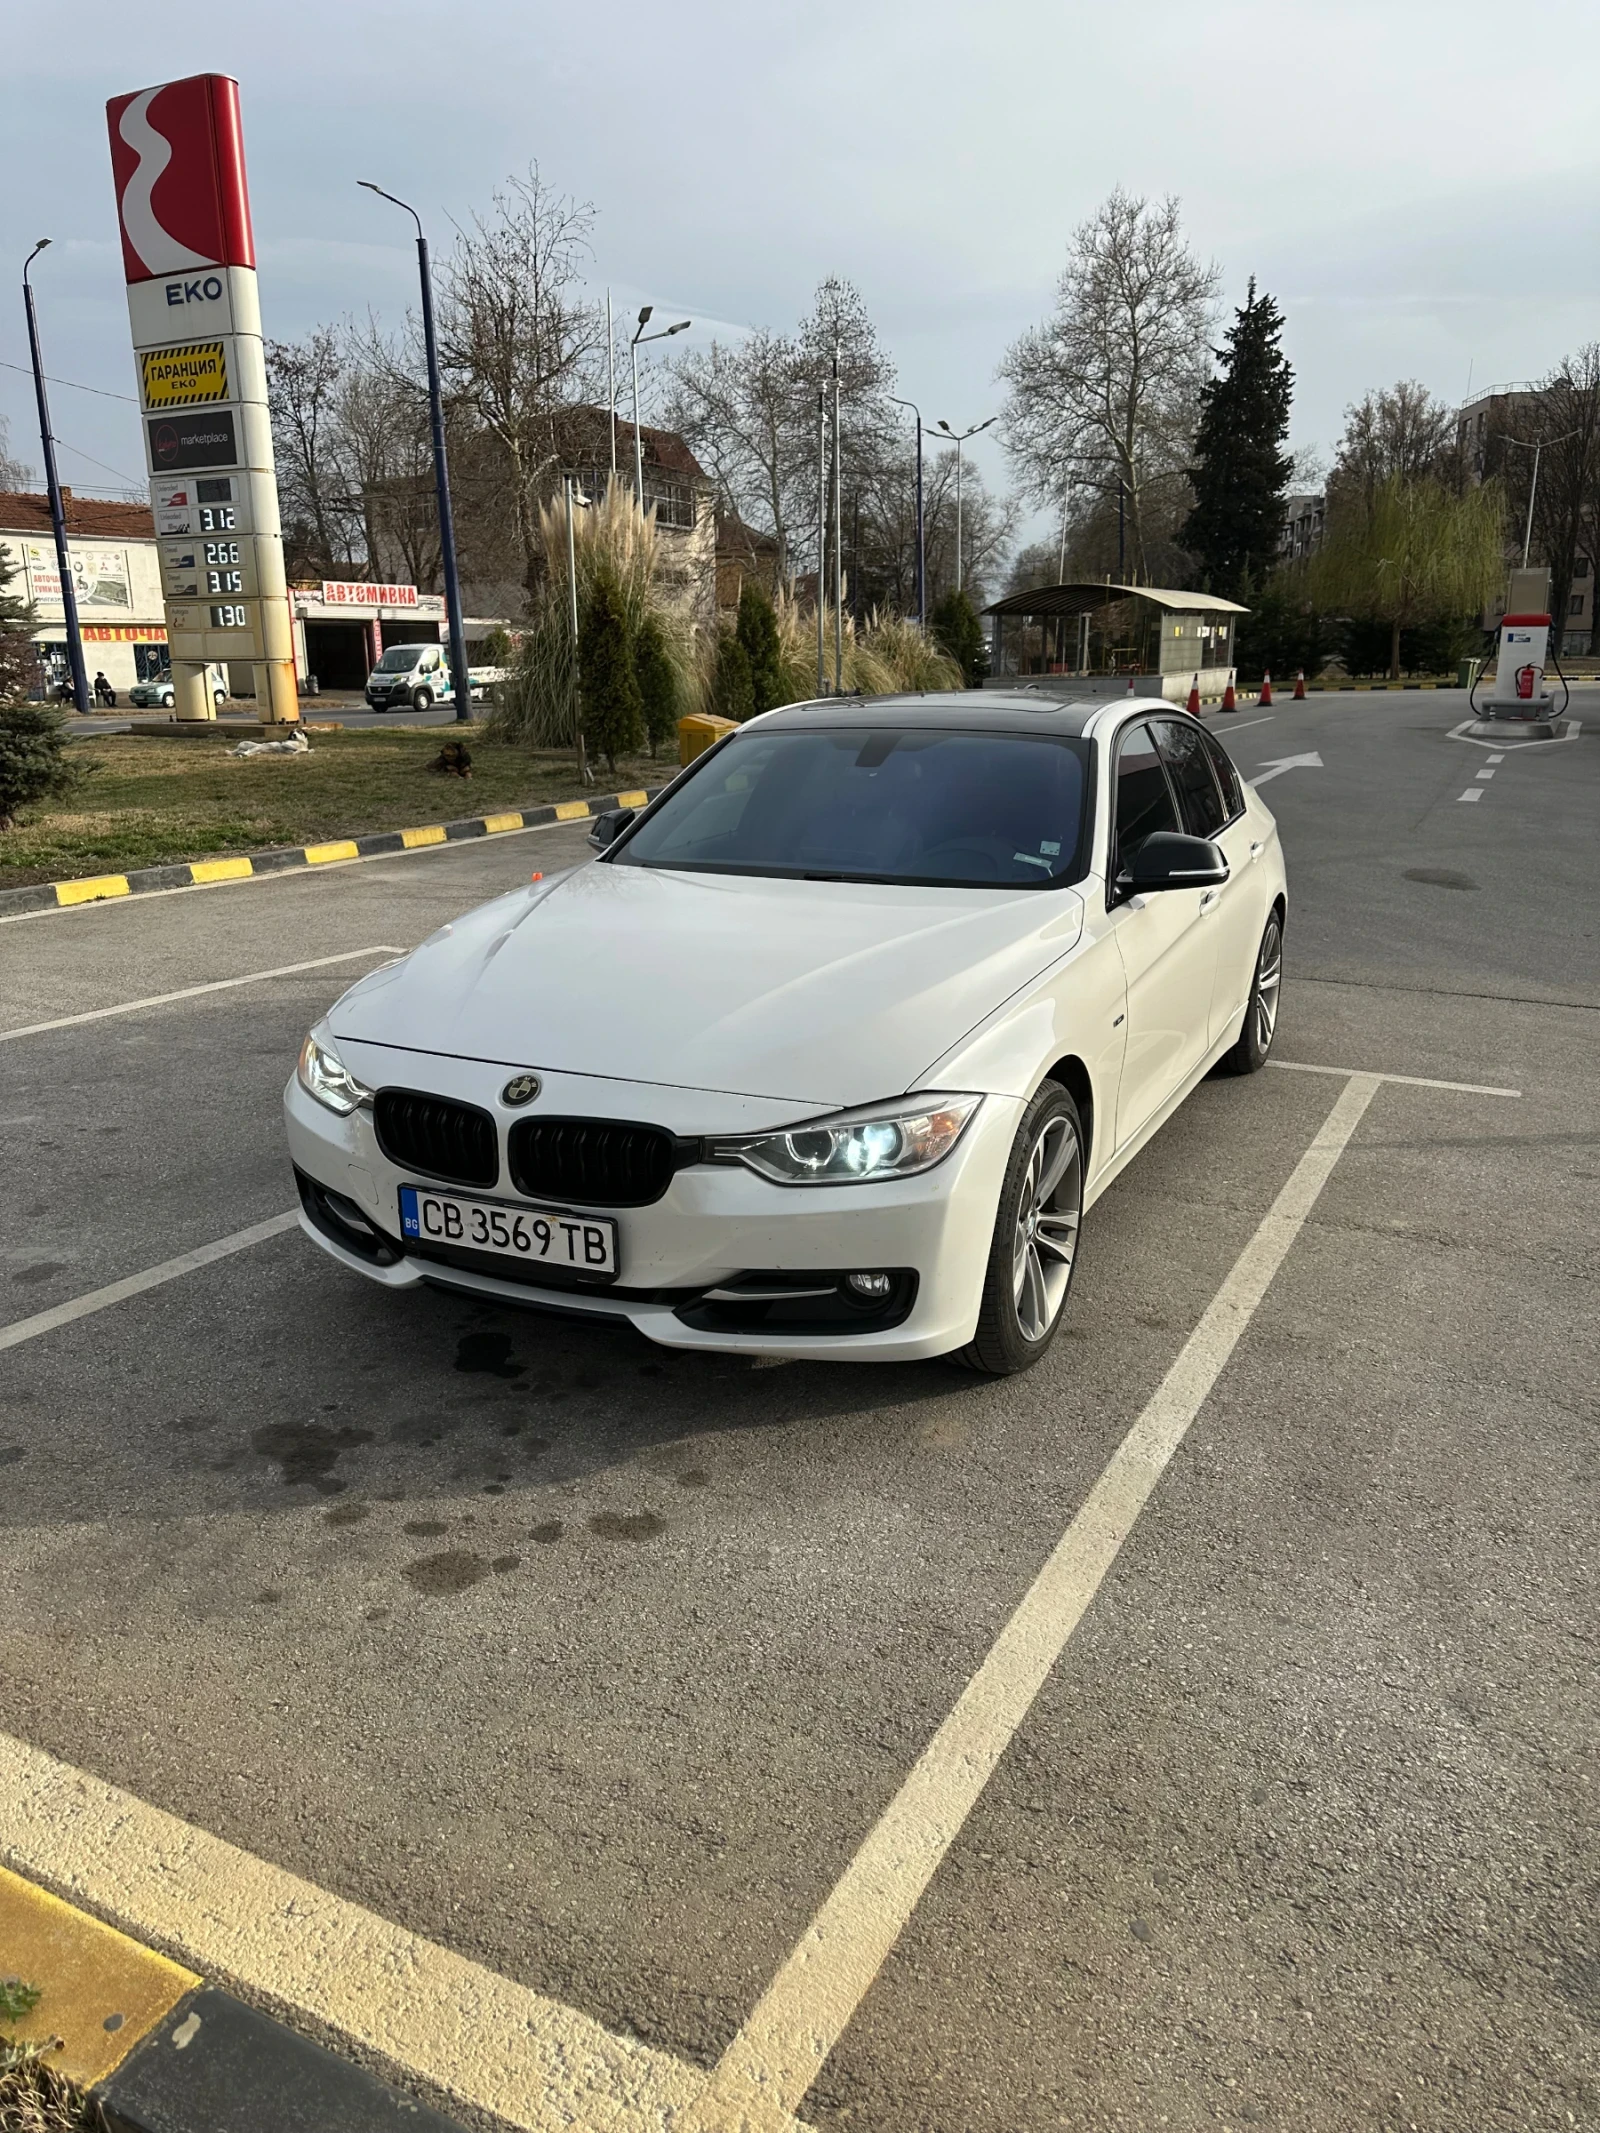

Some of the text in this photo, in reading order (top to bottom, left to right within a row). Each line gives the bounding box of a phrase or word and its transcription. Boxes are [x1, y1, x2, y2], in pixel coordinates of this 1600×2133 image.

[166, 277, 222, 306] EKO
[151, 359, 216, 381] ГАРАНЦИЯ
[181, 432, 228, 446] marketplace
[206, 543, 240, 565] 2.66
[33, 575, 61, 583] АВТОЧА
[326, 583, 416, 605] АВТОМИВКА
[83, 626, 167, 641] АВТОЧА
[405, 1217, 418, 1230] BG
[422, 1199, 607, 1265] CB 3569 TB
